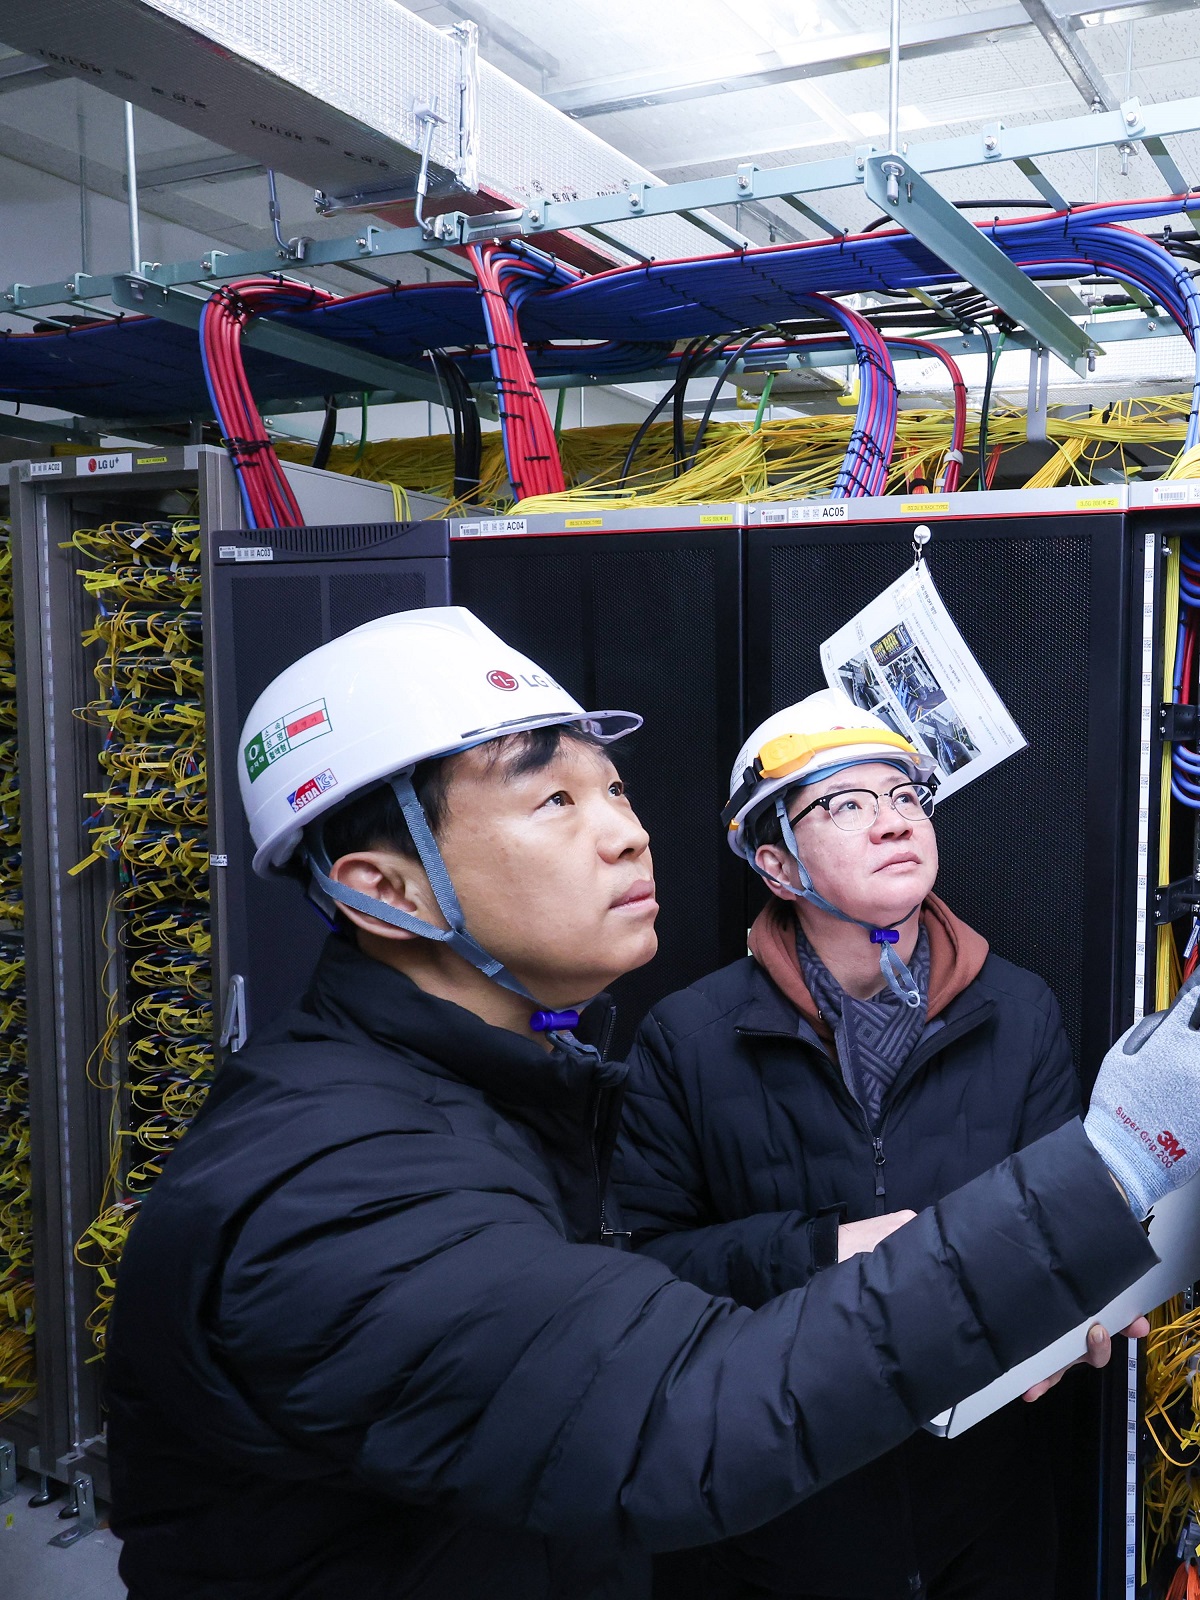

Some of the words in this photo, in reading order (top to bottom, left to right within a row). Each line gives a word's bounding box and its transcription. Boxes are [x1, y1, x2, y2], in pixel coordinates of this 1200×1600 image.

[98, 460, 108, 470] LG
[822, 507, 845, 517] AC05
[506, 521, 524, 531] AC04
[256, 548, 271, 557] AC03
[520, 675, 549, 687] LG
[292, 786, 320, 810] SSEDA
[1116, 1107, 1140, 1131] Super
[1140, 1131, 1157, 1151] Grip
[1156, 1151, 1173, 1168] 200
[1157, 1131, 1187, 1162] 3M
